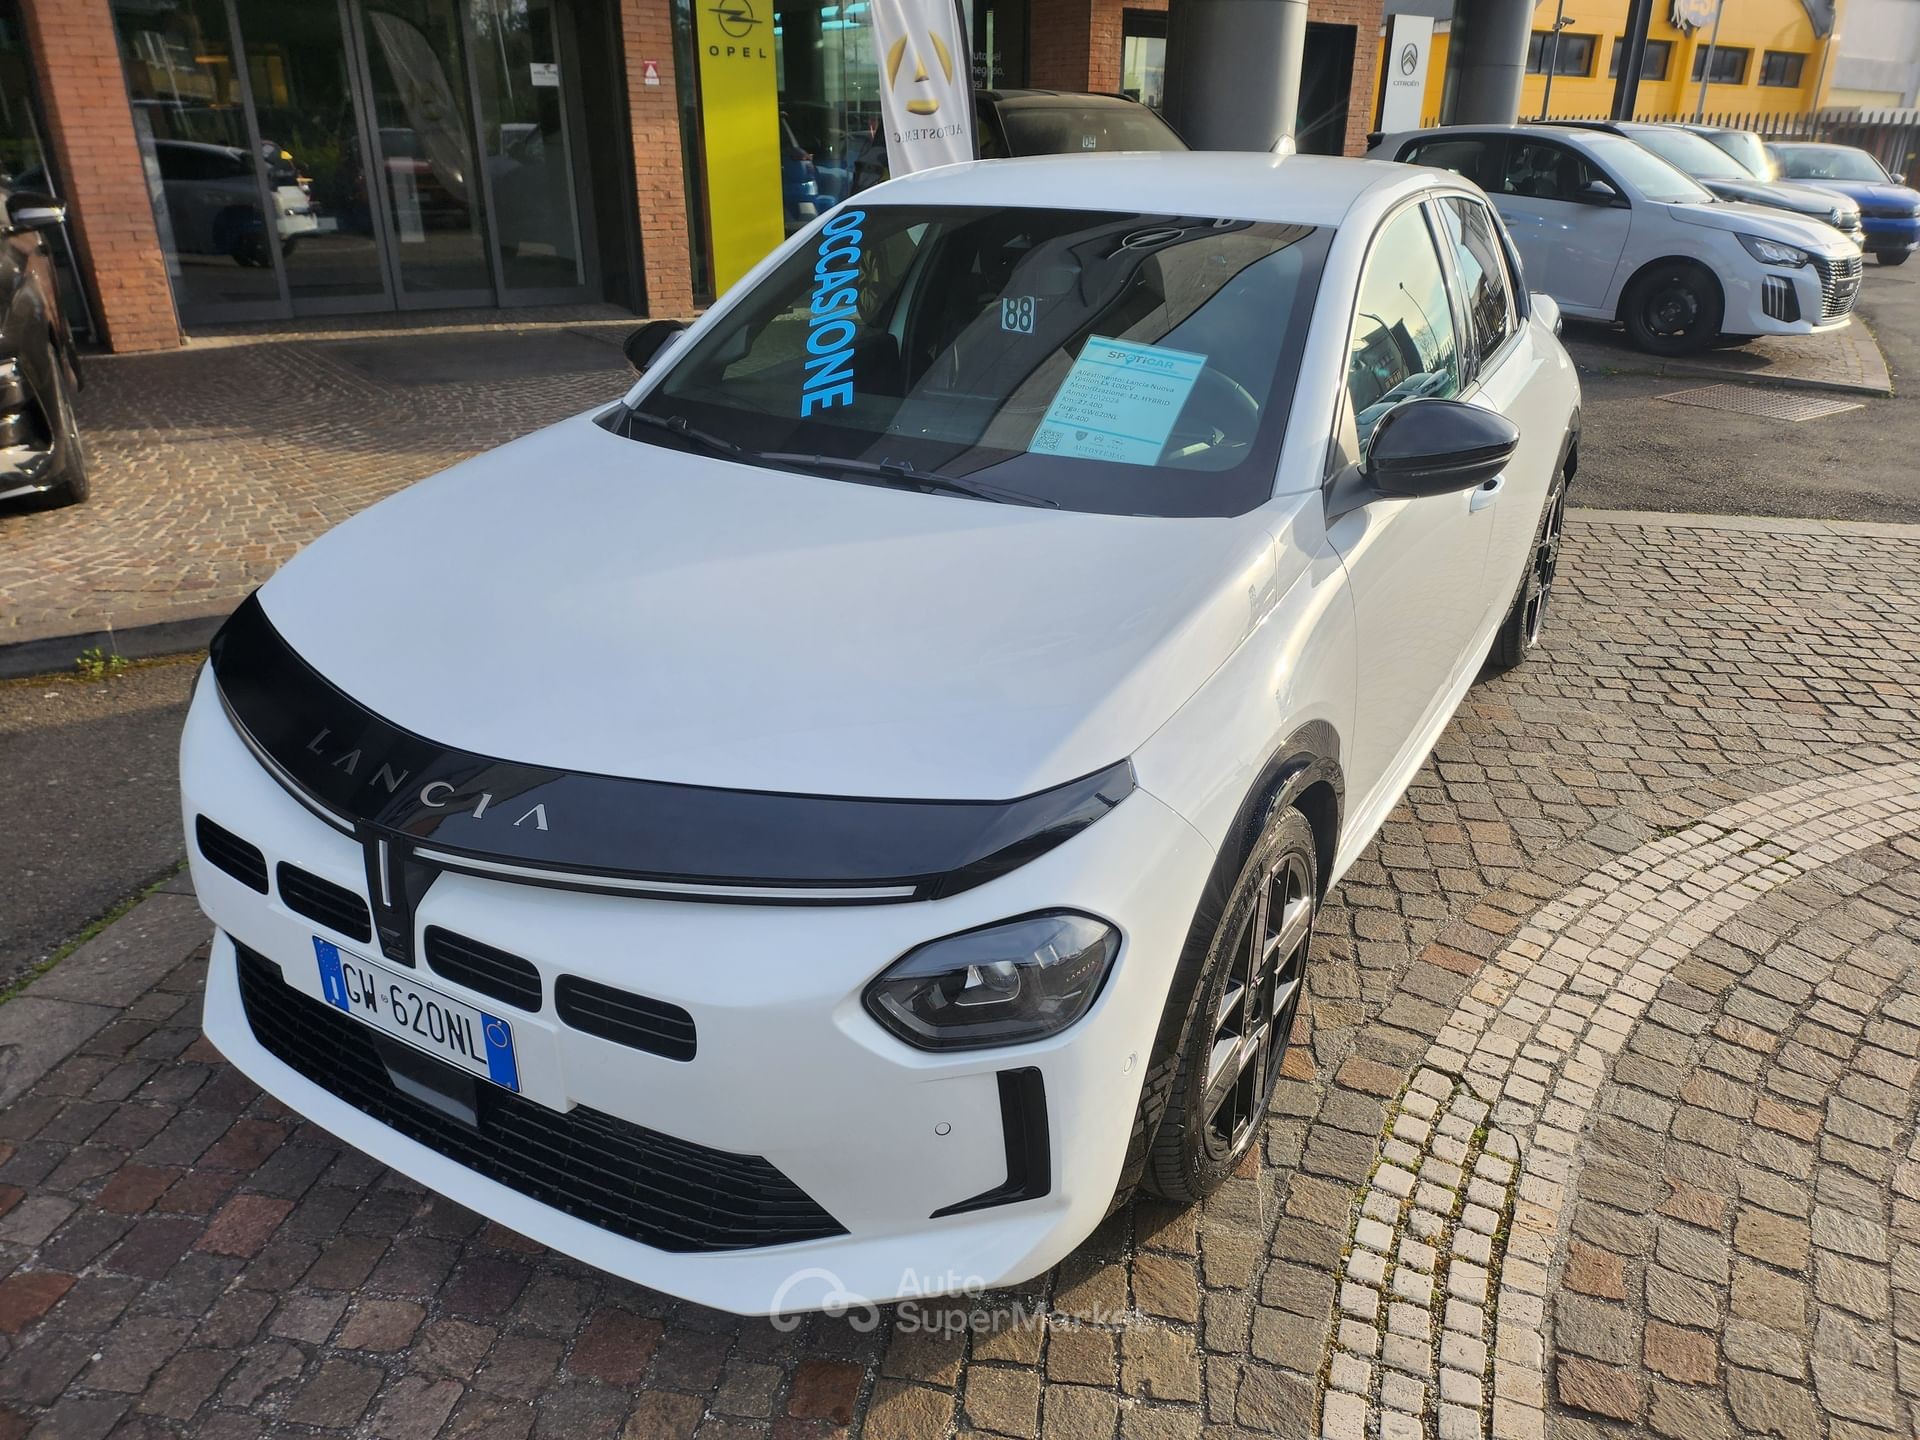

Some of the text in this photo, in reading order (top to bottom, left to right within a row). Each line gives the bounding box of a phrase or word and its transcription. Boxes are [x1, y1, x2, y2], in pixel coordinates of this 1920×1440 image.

[709, 45, 766, 58] OPEL
[801, 211, 866, 417] OCCASIONE
[1004, 297, 1033, 331] 88
[306, 728, 549, 831] LANCIA
[342, 963, 378, 1013] GW
[389, 985, 488, 1065] 620NL
